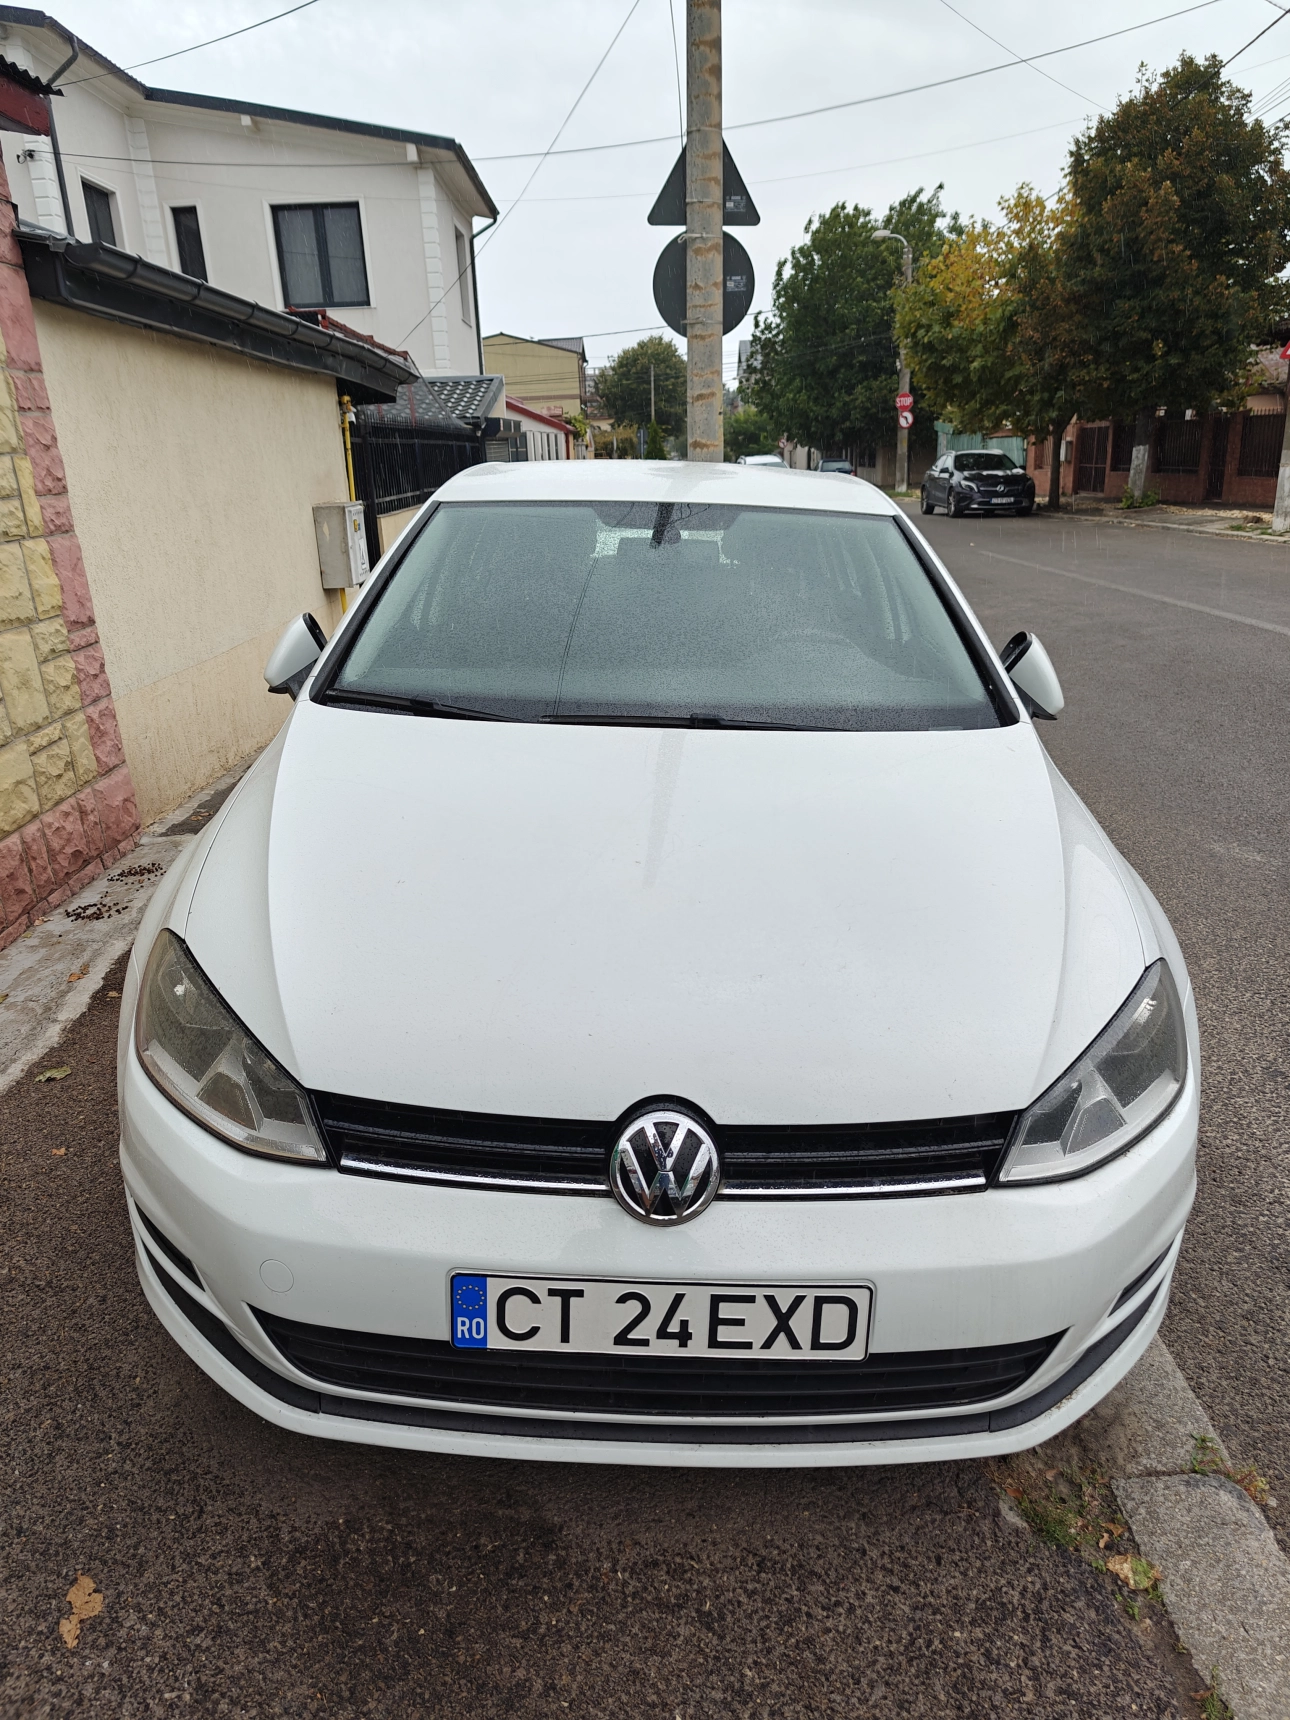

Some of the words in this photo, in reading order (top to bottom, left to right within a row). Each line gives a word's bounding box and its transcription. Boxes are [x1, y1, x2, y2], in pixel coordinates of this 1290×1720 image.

[896, 397, 912, 407] STOP
[496, 1286, 585, 1344] CT
[457, 1316, 485, 1339] RO
